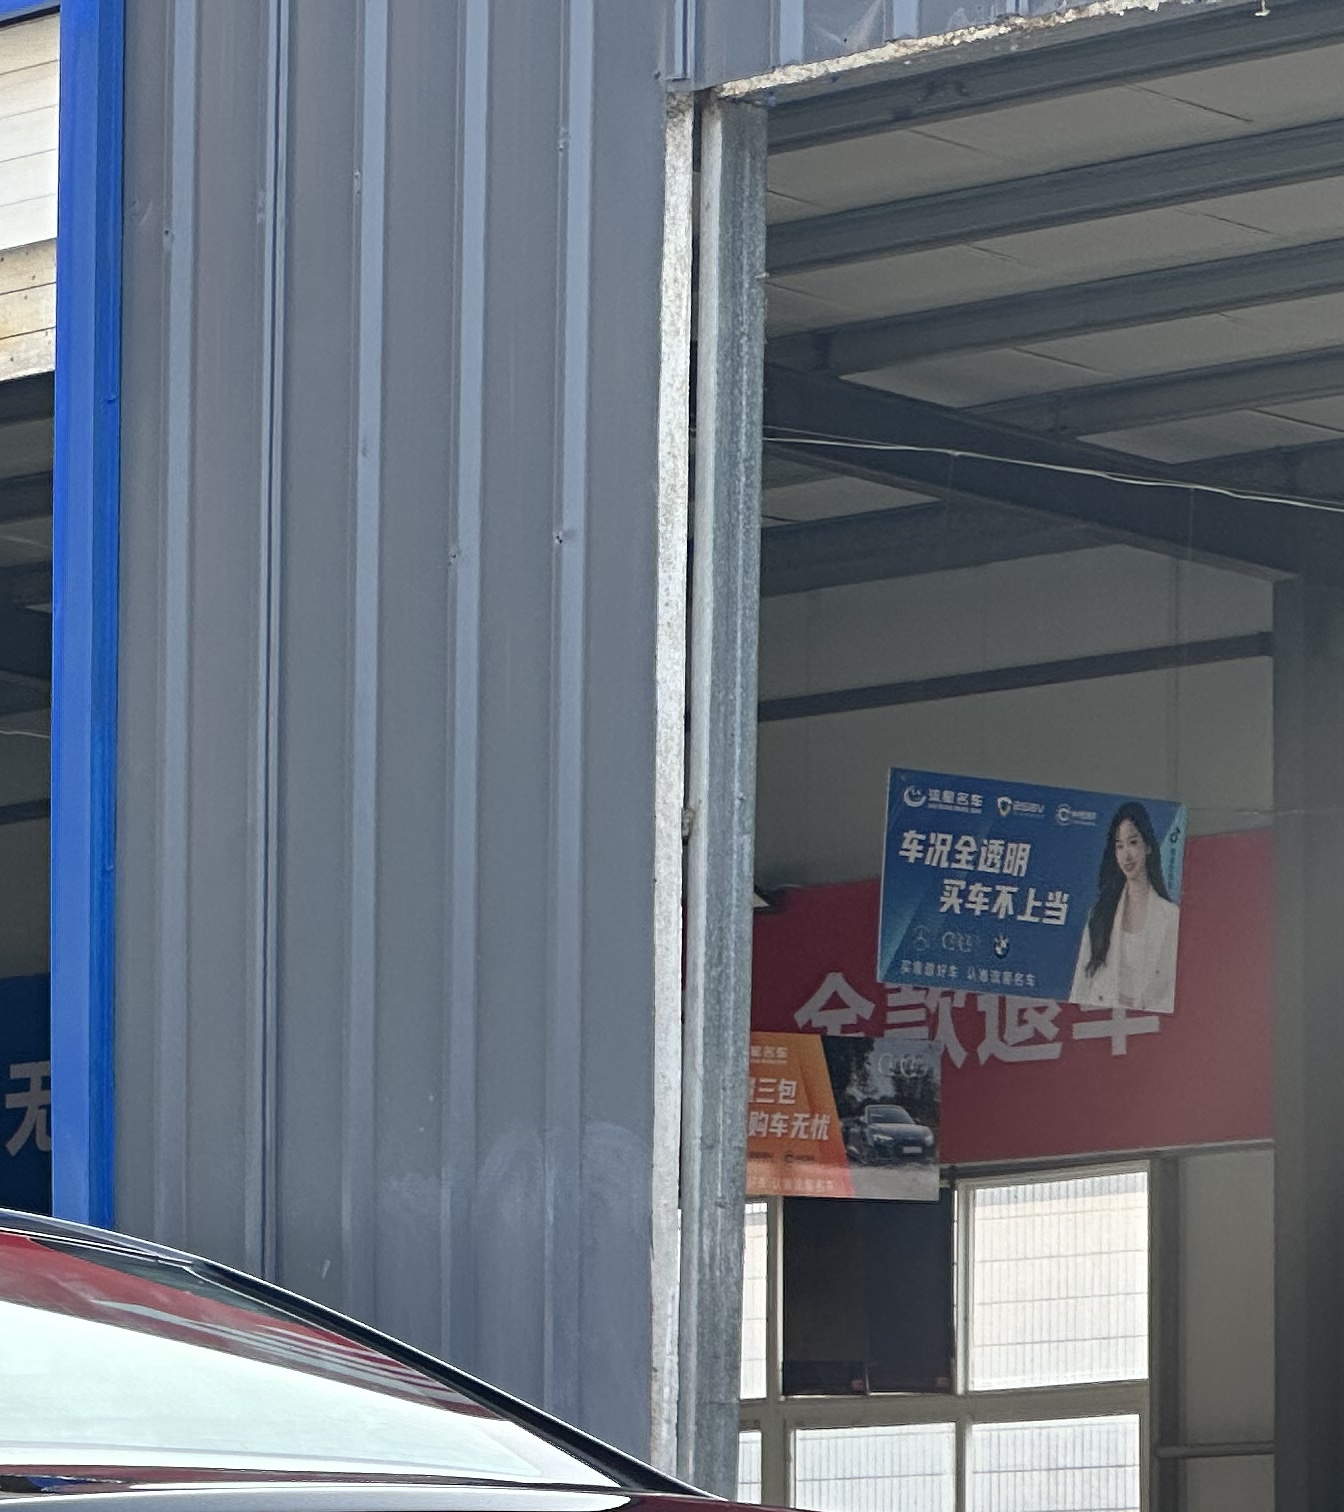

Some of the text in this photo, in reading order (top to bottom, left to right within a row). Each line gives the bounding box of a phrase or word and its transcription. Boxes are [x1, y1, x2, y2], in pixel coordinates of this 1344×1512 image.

[898, 830, 1032, 878] 车况全透明
[939, 878, 1070, 926] 买车不上当
[749, 1111, 831, 1140] 购车无忧
